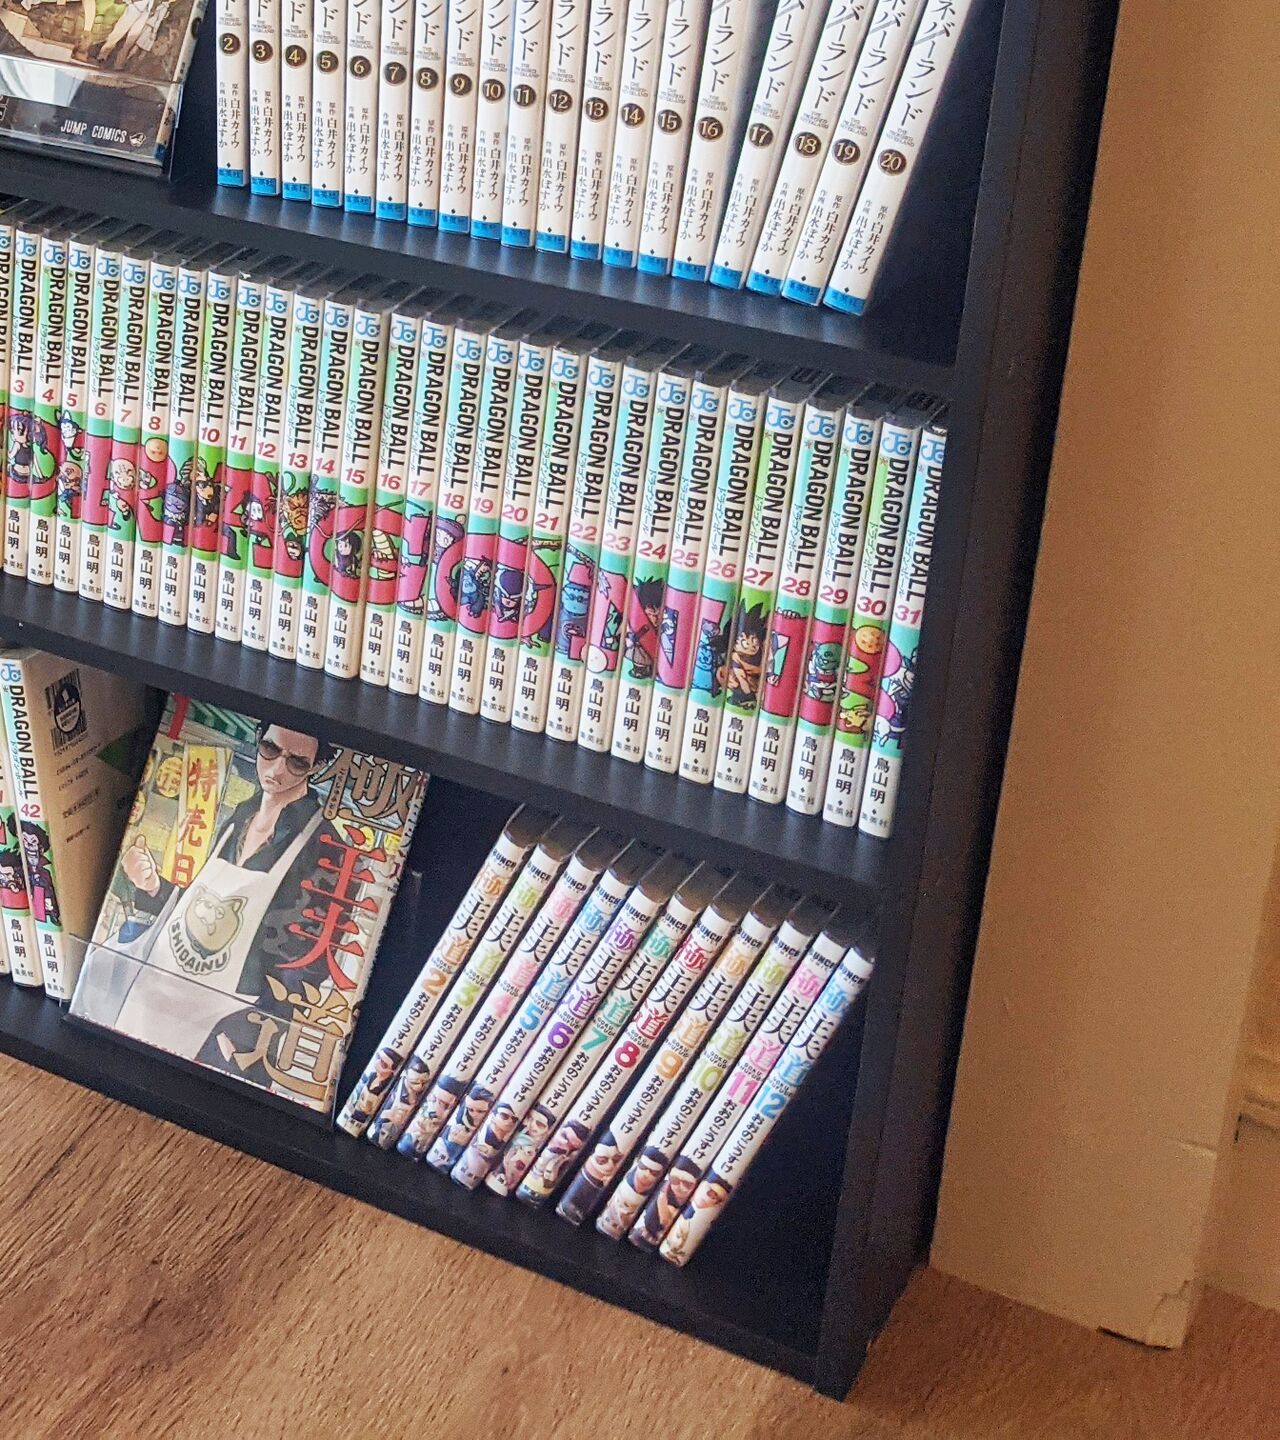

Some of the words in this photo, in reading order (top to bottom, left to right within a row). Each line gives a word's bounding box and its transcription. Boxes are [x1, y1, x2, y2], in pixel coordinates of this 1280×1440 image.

[223, 37, 234, 51] 2
[256, 43, 267, 59] 3
[319, 55, 332, 69] 5
[453, 77, 466, 93] 9
[60, 120, 88, 135] JUMP
[91, 126, 128, 144] COMICS
[326, 119, 337, 168] 白井カイウ
[751, 129, 767, 144] 17
[837, 141, 856, 160] 19
[881, 152, 901, 170] 20
[841, 216, 868, 269] 出水ぽすか
[858, 222, 883, 274] 白井カイウ
[19, 260, 36, 330] DRAGON
[17, 332, 33, 375] BALL
[209, 303, 229, 376] DRAGON
[14, 380, 24, 393] 3
[357, 340, 379, 416] DRAGON
[207, 380, 225, 423] BALL
[149, 416, 161, 430] 8
[201, 428, 220, 442] 10
[352, 419, 371, 464] BALL
[657, 407, 684, 485] DRAGON
[346, 468, 365, 485] 15
[802, 441, 833, 520] DRAGON
[651, 488, 674, 537] BALL
[36, 519, 48, 559] 鳥山明
[639, 541, 665, 559] 24
[795, 524, 820, 574] BALL
[193, 562, 206, 604] 鳥山明
[781, 577, 810, 596] 28
[857, 597, 886, 615] 30
[9, 685, 35, 757] DRAGON
[691, 708, 710, 753] 鳥山明
[19, 758, 40, 800] BALL
[835, 748, 856, 795] 鳥山明
[21, 804, 41, 818] 42
[170, 758, 220, 888] 特売日
[10, 919, 27, 958] 鳥山明
[227, 743, 421, 1107] 極主夫道
[170, 920, 228, 976] SHIDAINU
[424, 1004, 463, 1061] おおのこうすけ
[519, 1003, 543, 1031] 5
[548, 1022, 575, 1050] 6
[615, 1040, 641, 1068] 8
[547, 1052, 589, 1109] おおのこうすけ
[728, 1071, 759, 1105] 11
[755, 1086, 789, 1120] 12
[694, 1099, 736, 1159] おおのこうすけ
